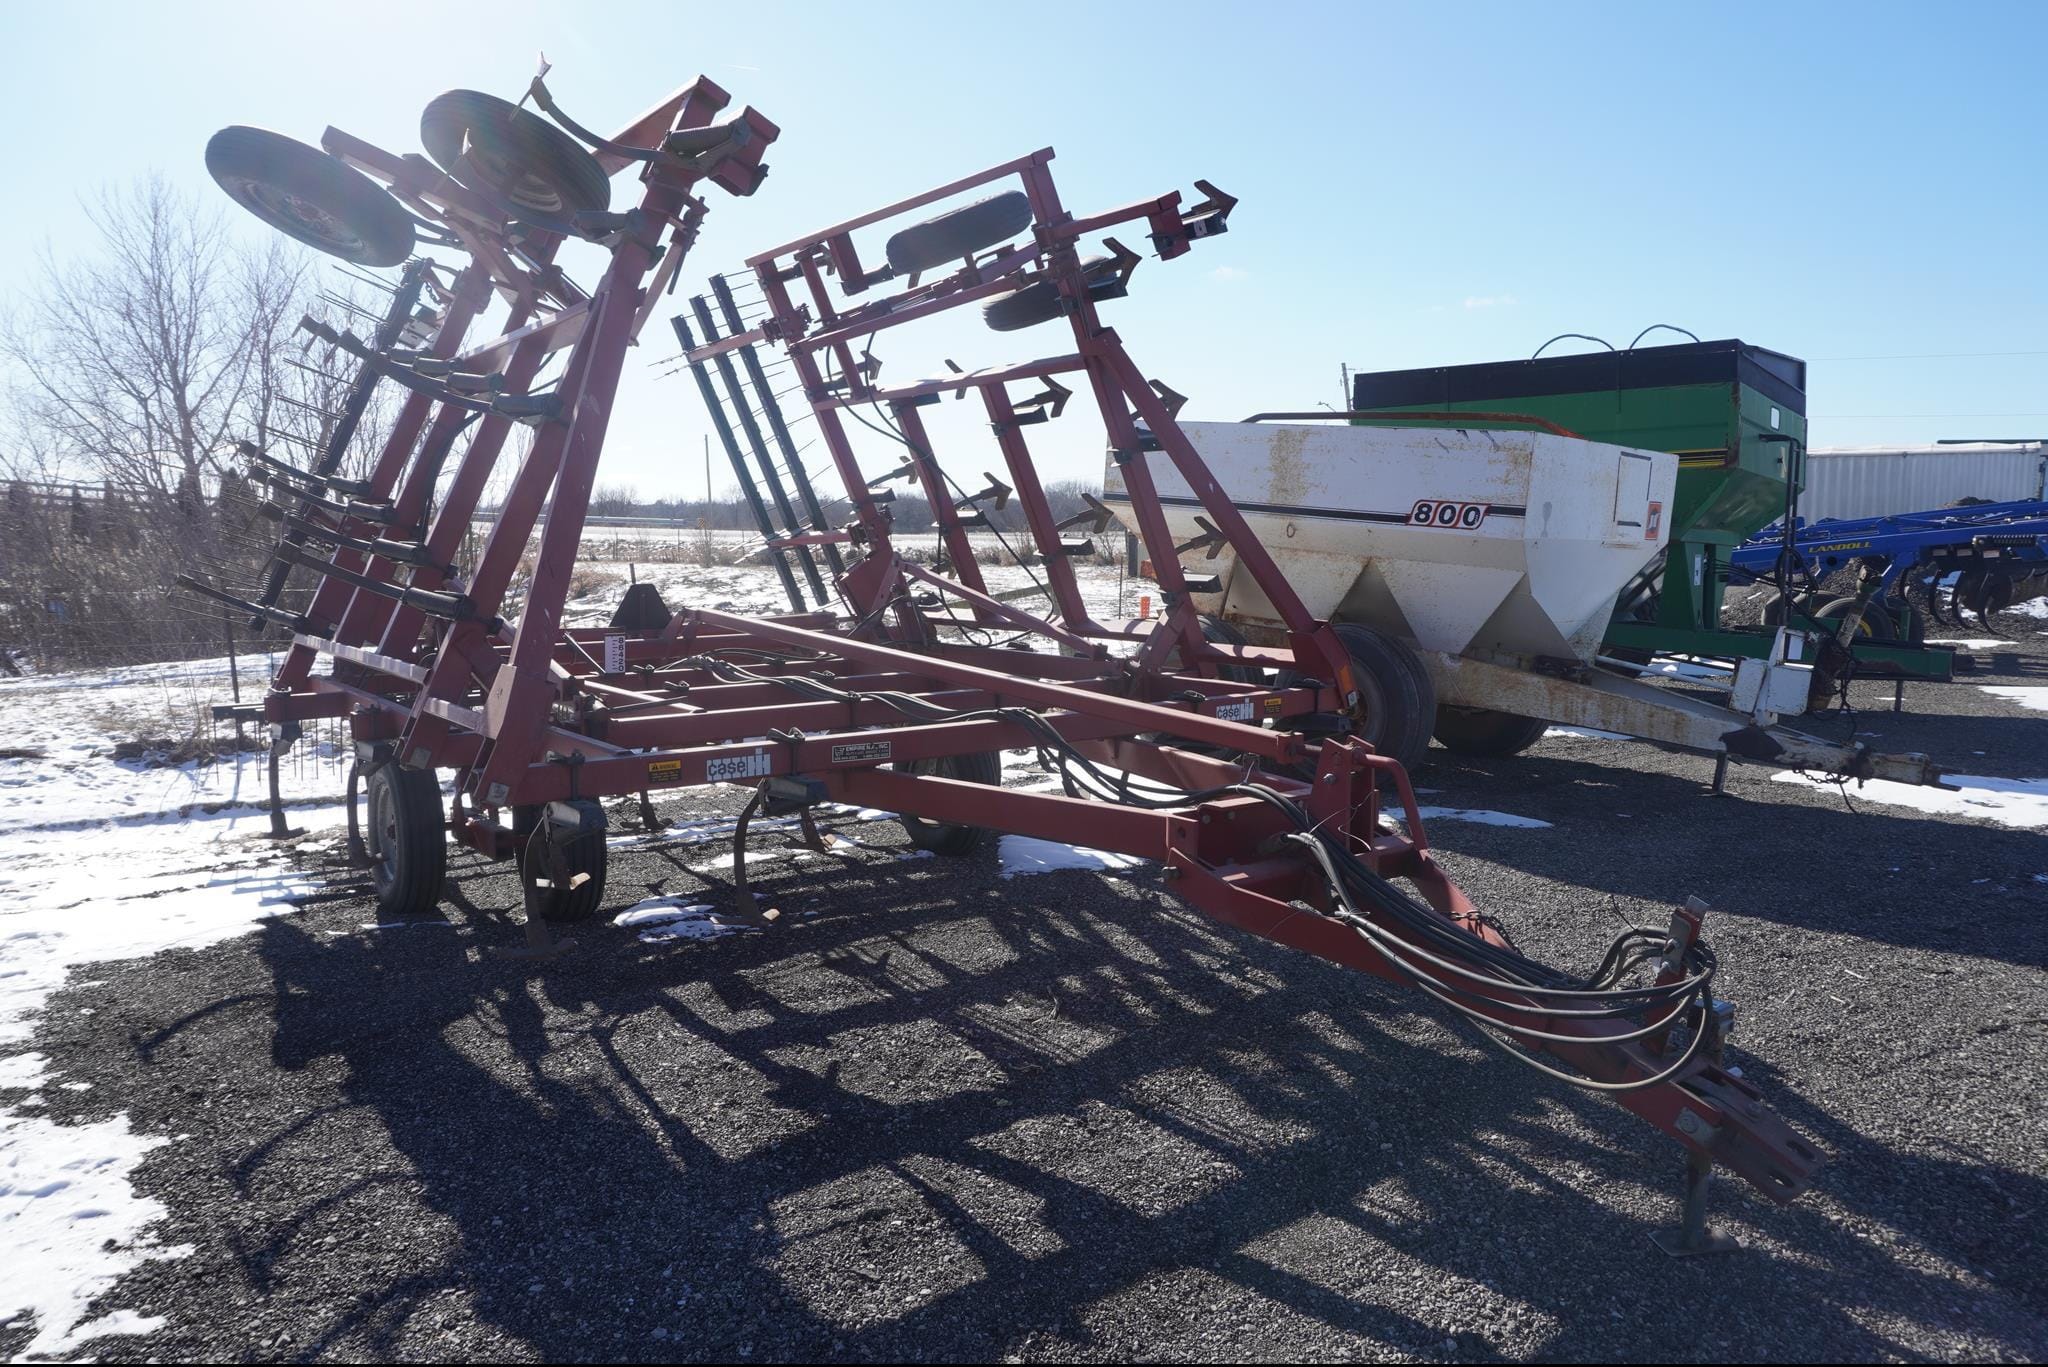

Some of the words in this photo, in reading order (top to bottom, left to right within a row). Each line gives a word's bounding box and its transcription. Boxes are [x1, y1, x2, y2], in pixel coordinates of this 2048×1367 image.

[1414, 503, 1481, 527] 800
[1808, 541, 1872, 554] LANDOLL
[707, 759, 746, 779] case
